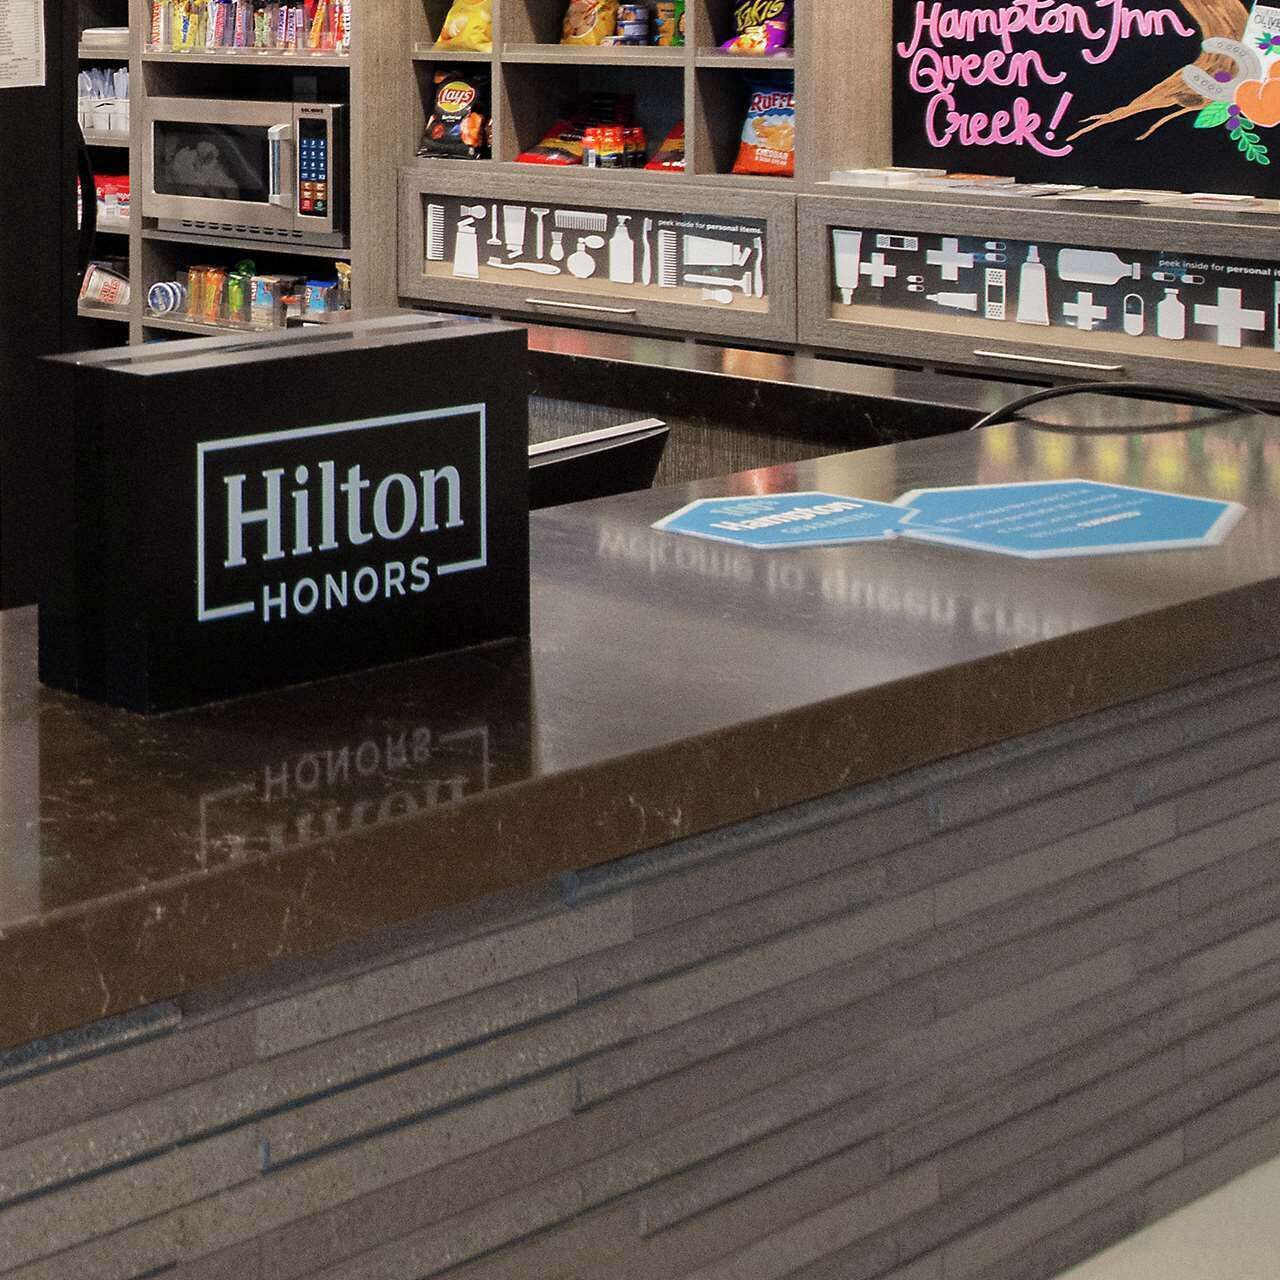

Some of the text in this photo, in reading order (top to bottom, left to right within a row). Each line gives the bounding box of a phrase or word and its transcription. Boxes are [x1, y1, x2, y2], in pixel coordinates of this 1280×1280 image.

[909, 48, 1067, 94] Queen
[926, 91, 1073, 157] Creek!
[706, 223, 738, 232] personal
[1159, 260, 1180, 268] peek
[1183, 260, 1209, 270] inside
[1211, 263, 1225, 272] for
[1226, 265, 1271, 276] personal
[224, 460, 464, 568] Hilton
[263, 557, 430, 621] HONORS
